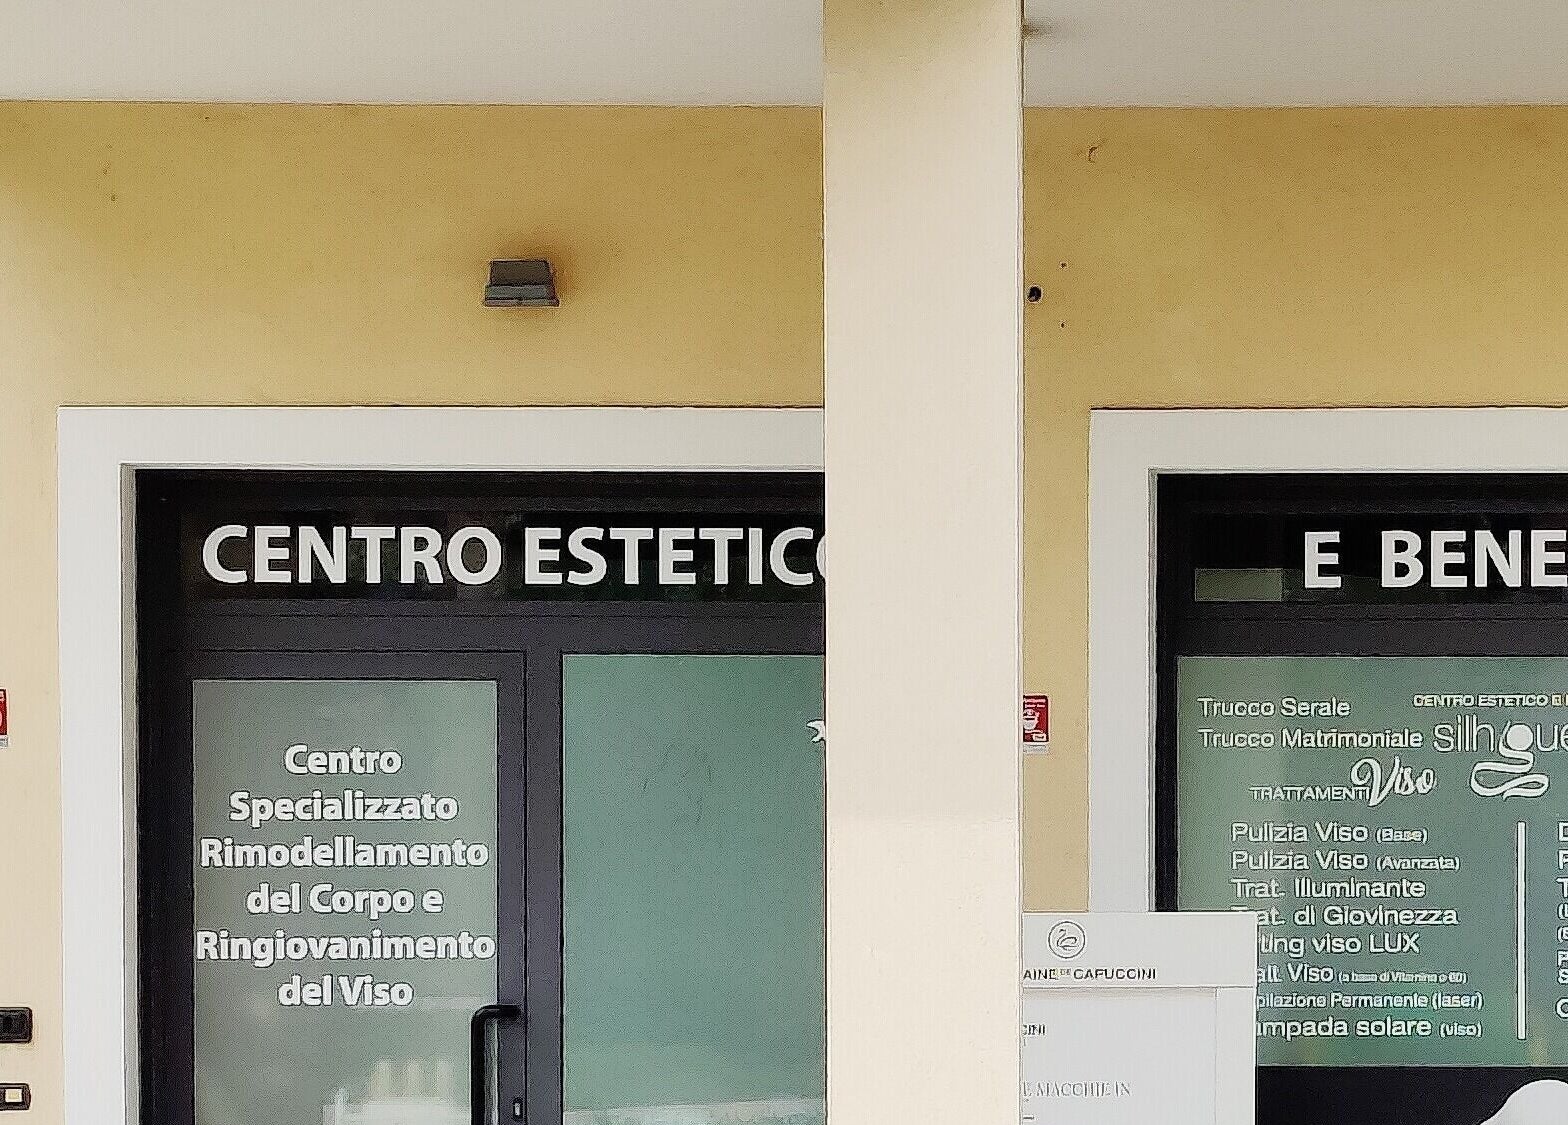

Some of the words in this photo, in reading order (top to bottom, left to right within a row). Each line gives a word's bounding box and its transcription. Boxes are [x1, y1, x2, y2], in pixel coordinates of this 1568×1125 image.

[202, 525, 502, 585] CENTRO
[524, 526, 826, 585] ESTETIC
[1304, 531, 1341, 589] E
[1197, 696, 1275, 717] Trucco
[1280, 696, 1351, 717] Serale
[1413, 693, 1473, 706] CENTRO
[1477, 693, 1548, 706] ESTETICO
[1198, 729, 1275, 748] Trucco
[1281, 727, 1423, 748] Matrimoniale
[284, 744, 402, 776] Centro
[1250, 786, 1370, 801] TRATTAMENTI
[1350, 755, 1436, 807] Viso
[229, 790, 459, 826] Specializzato
[1231, 822, 1309, 842] Pulizia
[1315, 821, 1369, 842] Viso
[1376, 828, 1428, 844] (Base)
[200, 836, 490, 869] Rimodellamento
[1231, 850, 1309, 870] Pulizia
[1315, 849, 1368, 870] Viso
[1376, 856, 1461, 871] (Avanzata)
[1230, 878, 1286, 898] Trat.
[1293, 877, 1426, 898] Illuminante
[246, 882, 302, 916] del
[309, 883, 416, 921] Corpo
[423, 889, 444, 916] e
[1293, 905, 1316, 926] di
[1322, 905, 1459, 926] Giovinezza
[195, 930, 496, 968] Ringiovanimento
[1259, 933, 1305, 957] ting
[1311, 933, 1362, 953] viso
[1369, 933, 1420, 953] LUX
[1023, 968, 1060, 981] AINE
[1073, 968, 1157, 981] CAPUCCINI
[1287, 963, 1335, 982] Viso
[277, 974, 335, 1007] del
[340, 975, 414, 1007] Viso
[1257, 993, 1327, 1013] pilazione
[1331, 992, 1429, 1008] Permanente
[1431, 991, 1484, 1011] (laser)
[1355, 1016, 1432, 1037] solare
[1439, 1022, 1482, 1038] (viso)
